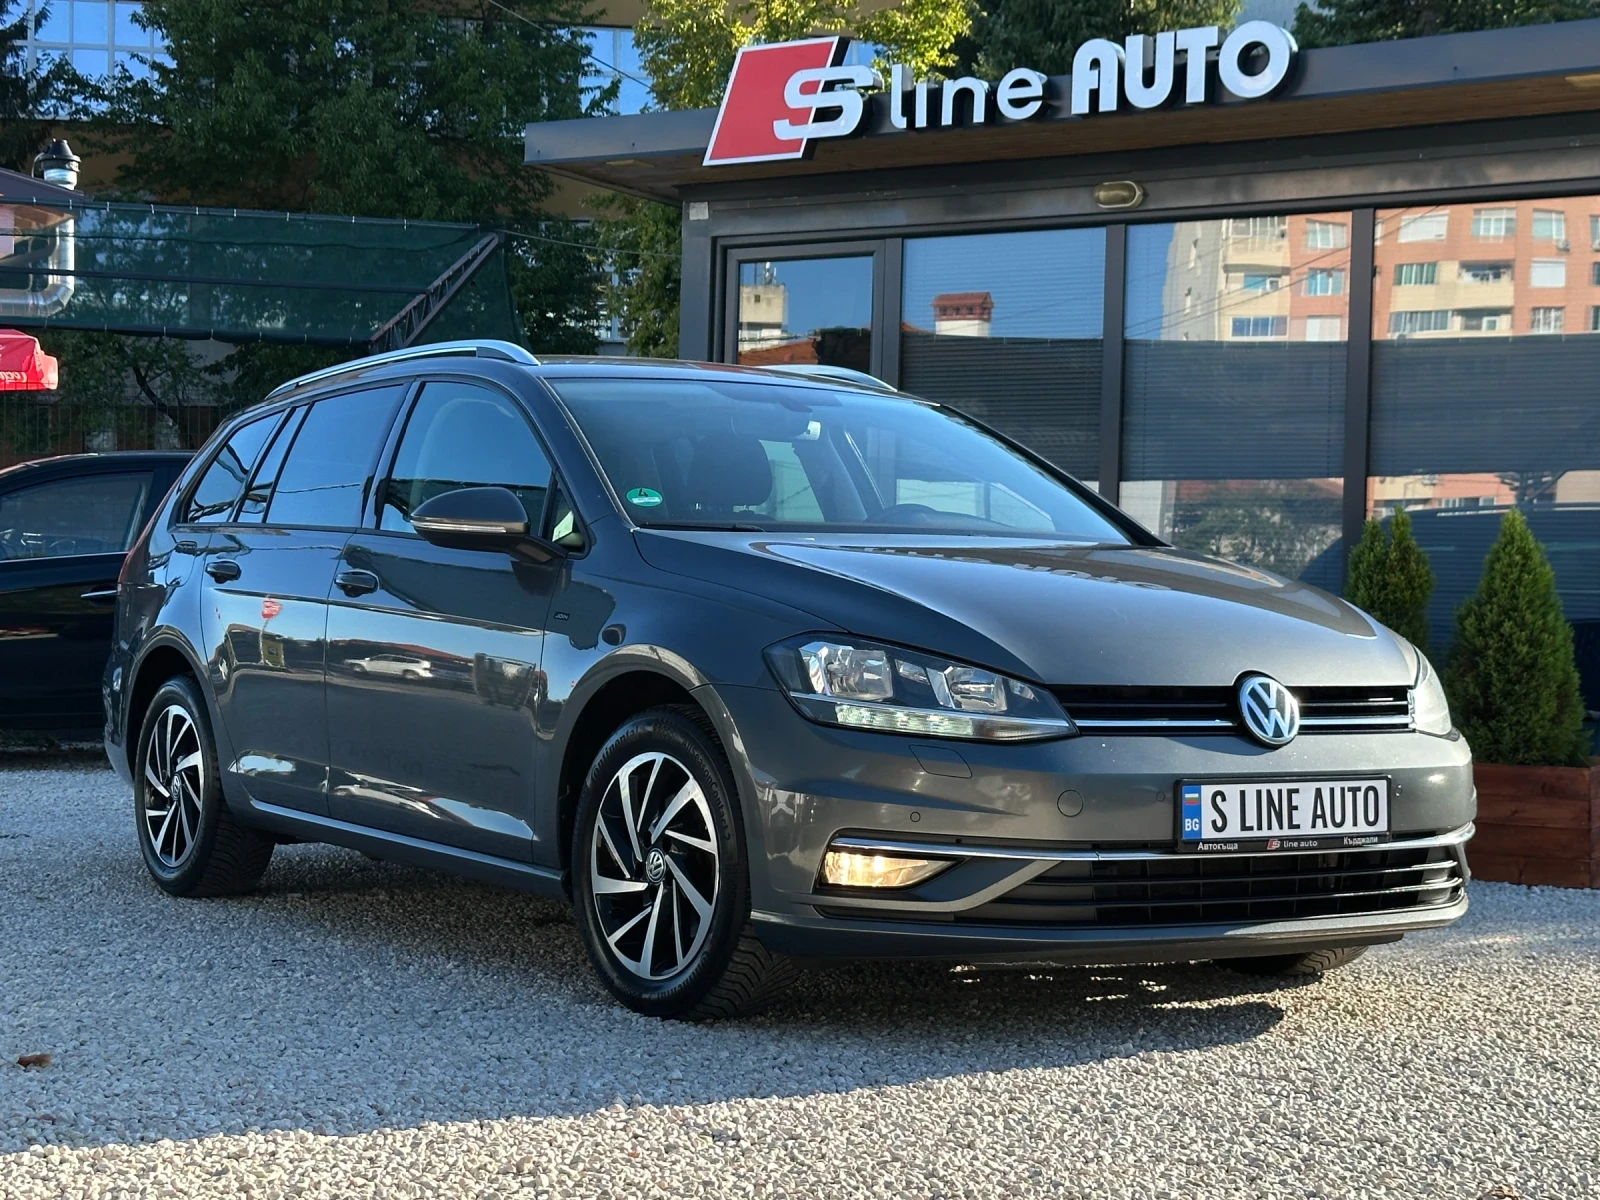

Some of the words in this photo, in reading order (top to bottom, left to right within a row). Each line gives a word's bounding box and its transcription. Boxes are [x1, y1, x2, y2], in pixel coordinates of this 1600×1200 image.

[773, 65, 876, 140] S
[891, 64, 1046, 128] line
[1071, 20, 1295, 114] AUTO
[1240, 676, 1299, 744] VW
[1210, 789, 1228, 833] S
[1239, 787, 1301, 832] LINE
[1310, 785, 1380, 829] AUTO
[1185, 818, 1199, 831] BG
[1197, 842, 1238, 851] Автокъща
[1283, 840, 1299, 848] line
[1343, 836, 1378, 845] Кърджали
